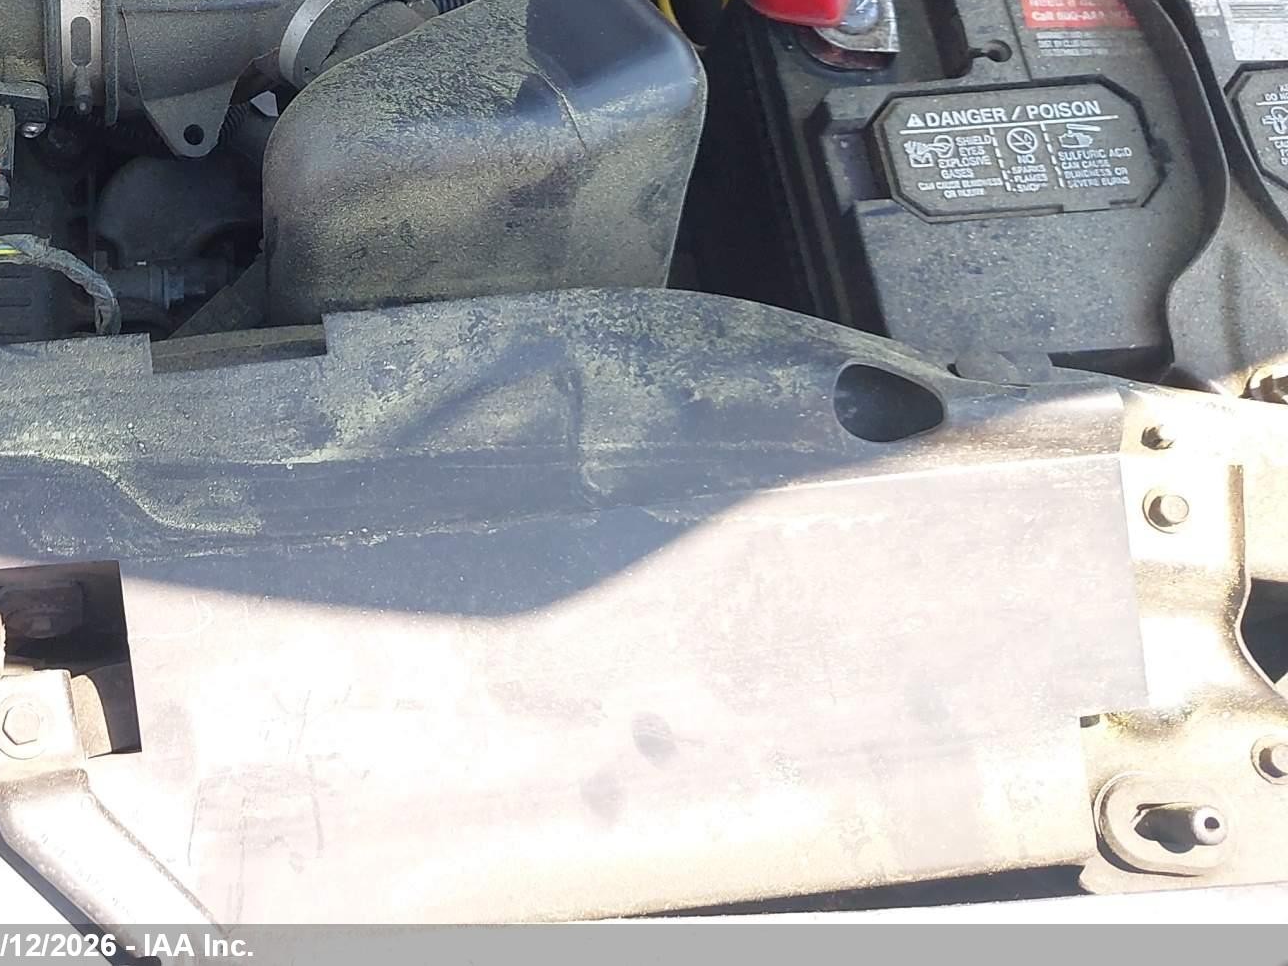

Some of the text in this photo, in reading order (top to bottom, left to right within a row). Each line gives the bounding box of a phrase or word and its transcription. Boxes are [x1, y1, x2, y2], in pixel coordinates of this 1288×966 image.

[924, 107, 1008, 127] DANGER
[1026, 100, 1102, 119] POISON
[955, 134, 992, 146] SHIELD
[958, 146, 986, 157] EYES
[1058, 146, 1133, 161] SULFURIC ACID
[937, 155, 992, 168] EXPLOSIVE
[1017, 154, 1036, 164] NO
[1061, 161, 1080, 170] CAN
[941, 168, 975, 179] GASES
[1114, 167, 1128, 176] OR
